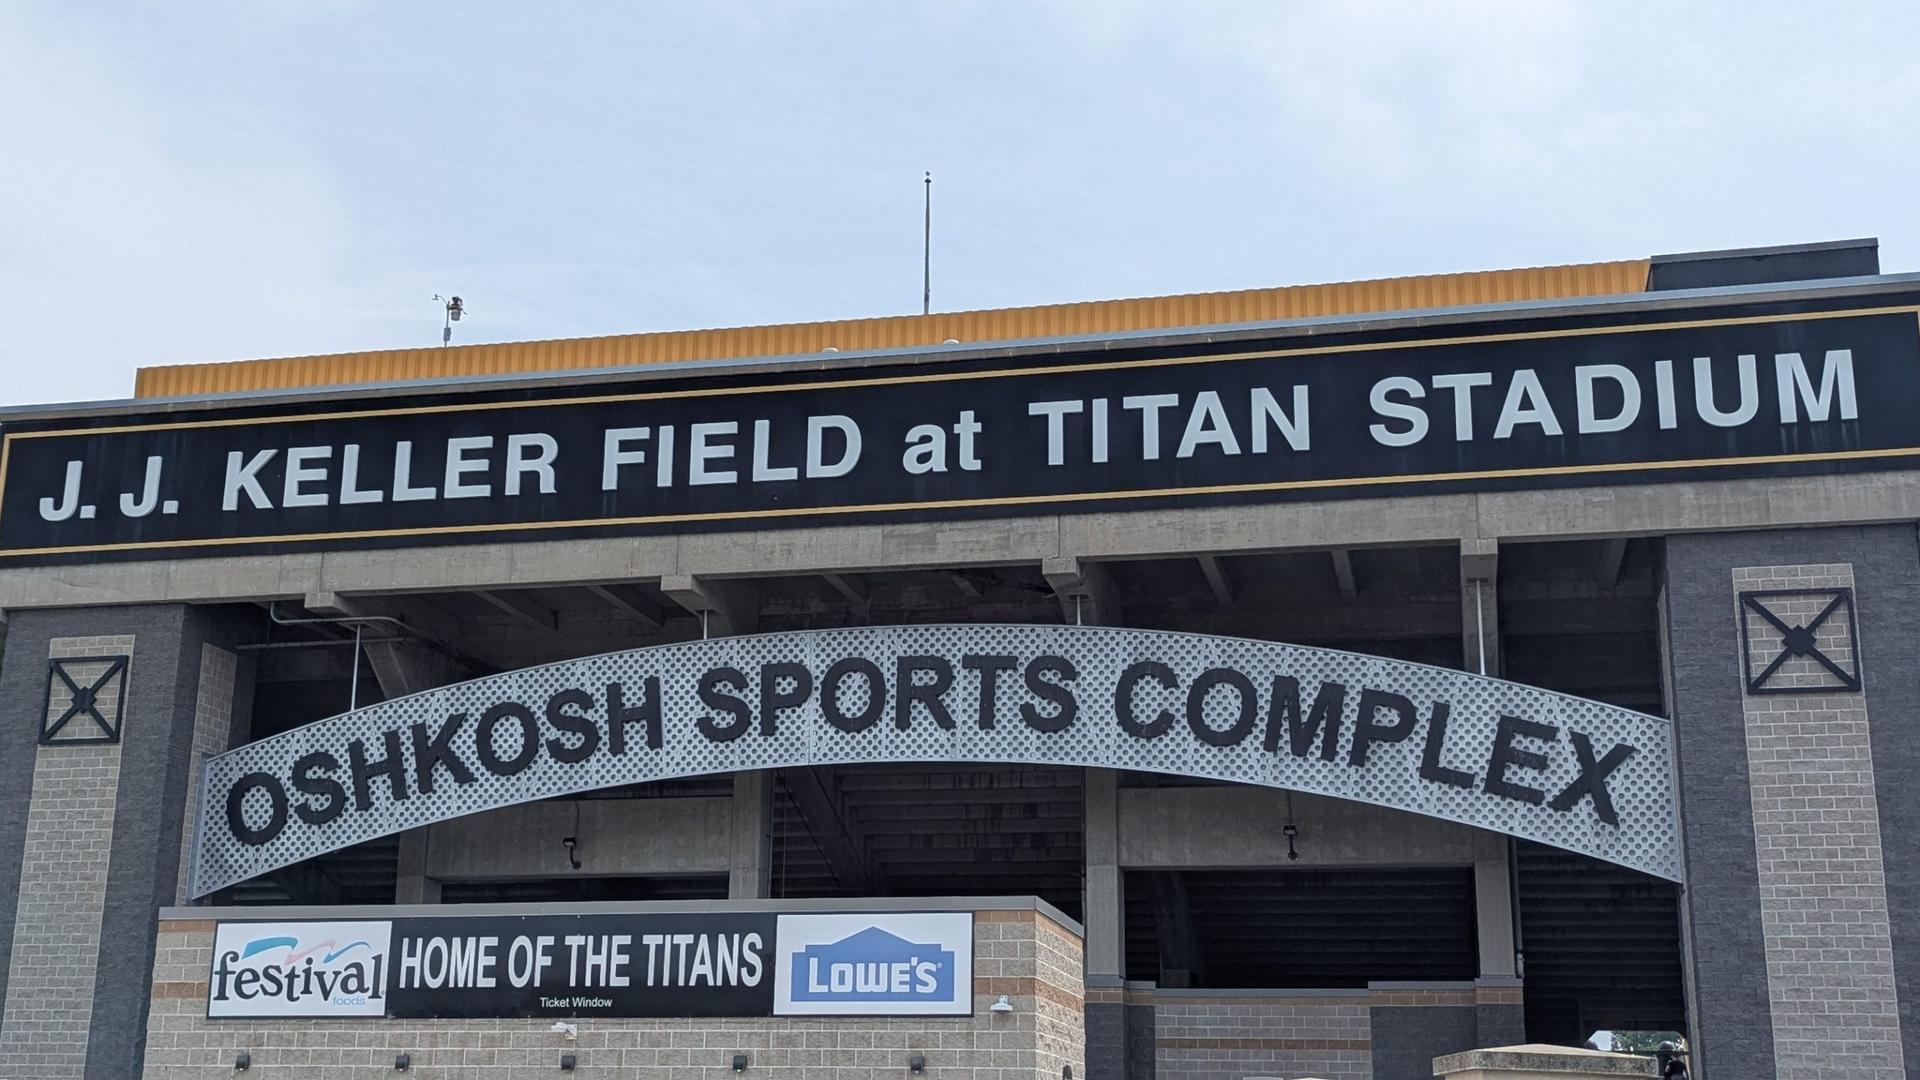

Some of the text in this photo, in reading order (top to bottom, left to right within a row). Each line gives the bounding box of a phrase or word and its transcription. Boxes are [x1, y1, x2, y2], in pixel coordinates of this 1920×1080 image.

[39, 349, 1859, 522] J. J. KELLER FIELD at TITAN STADIUM
[226, 655, 1638, 846] OSHKOSH SPORTS COMPLEX
[213, 951, 383, 1002] festival
[399, 932, 763, 989] HOME OF THE TITANS
[808, 956, 938, 993] LOWE'S
[332, 996, 366, 1006] foods
[540, 996, 613, 1008] Ticket Window
